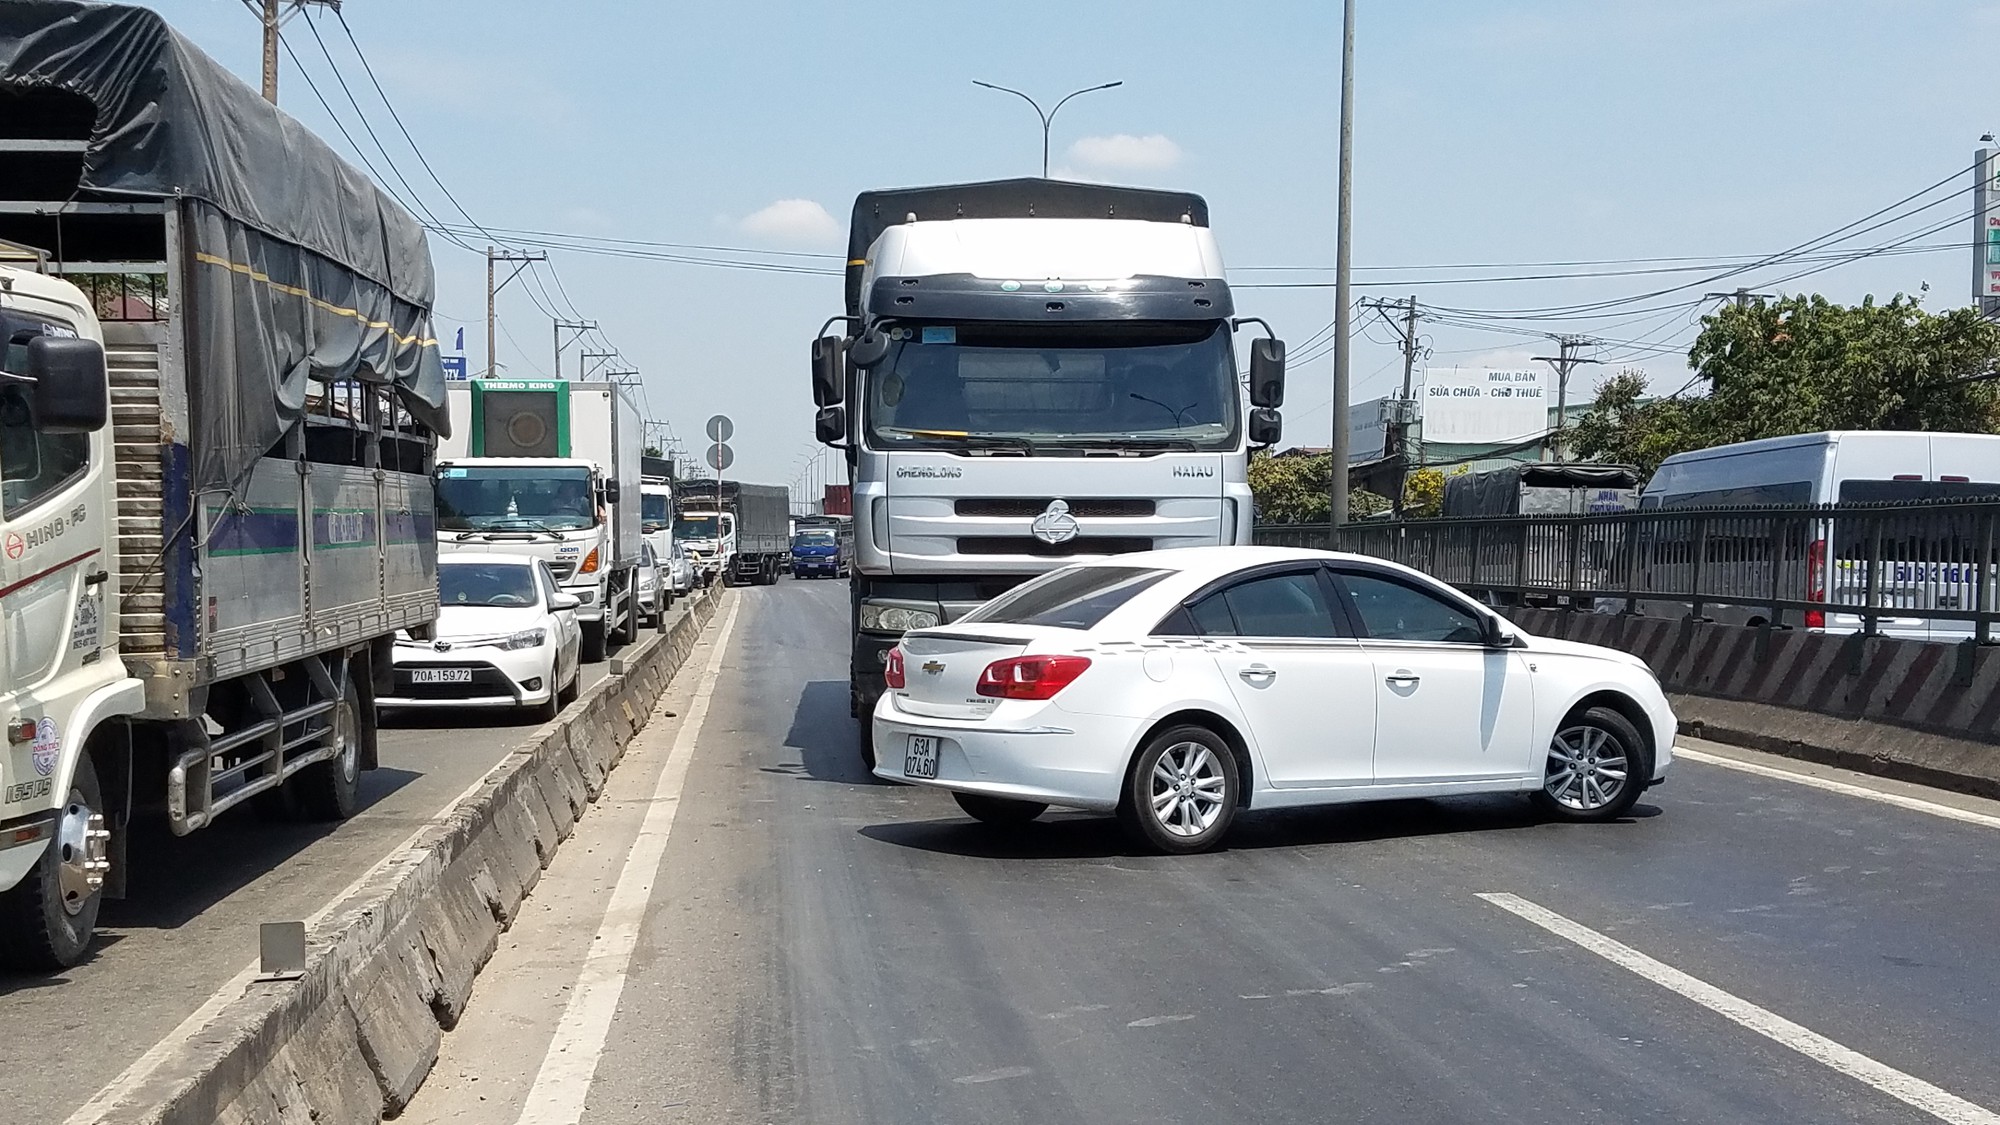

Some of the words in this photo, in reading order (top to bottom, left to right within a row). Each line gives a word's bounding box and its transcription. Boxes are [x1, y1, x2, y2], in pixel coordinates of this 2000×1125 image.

[1514, 370, 1536, 382] BÁN
[1429, 384, 1450, 397] SỬA
[1452, 385, 1481, 397] CHỮA
[1515, 386, 1543, 398] THUÊ
[896, 466, 962, 478] CHENGLONG
[25, 517, 65, 550] HINO
[414, 669, 471, 682] 70A-159.72
[914, 737, 930, 757] 63A
[906, 756, 935, 776] 074.60
